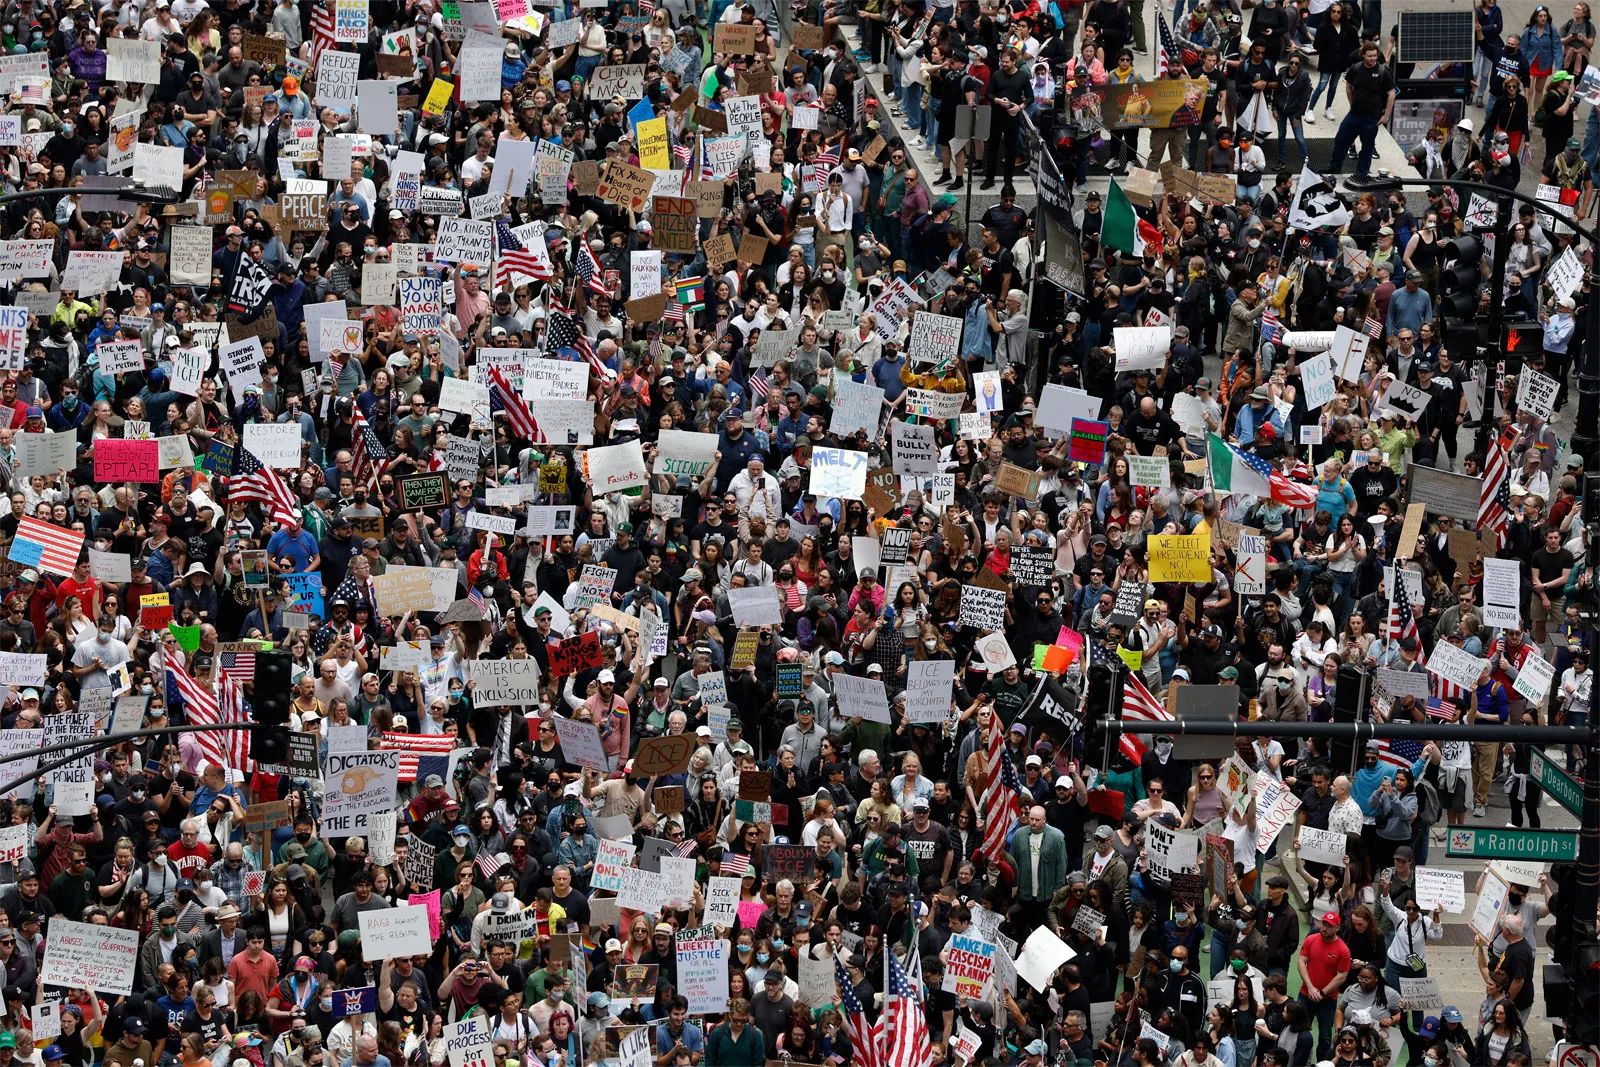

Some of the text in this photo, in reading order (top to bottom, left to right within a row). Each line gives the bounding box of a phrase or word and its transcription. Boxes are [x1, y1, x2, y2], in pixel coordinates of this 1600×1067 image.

[338, 10, 366, 19] KINGS
[338, 20, 366, 28] NO
[338, 29, 367, 38] FASCISTS
[323, 54, 358, 67] REFUSE
[320, 70, 356, 83] RESIST
[319, 84, 355, 100] REVOLT
[597, 85, 639, 98] MAGA
[742, 102, 757, 112] The
[730, 112, 761, 124] PEOPLE
[1395, 120, 1426, 128] Time
[1395, 131, 1408, 140] to
[118, 152, 134, 162] KINGS
[542, 142, 571, 163] HATE
[716, 152, 735, 162] LIES
[399, 172, 408, 181] NO
[294, 182, 313, 192] NO
[397, 181, 419, 190] KINGS
[396, 190, 418, 198] SINCE
[607, 187, 630, 205] Die
[281, 195, 326, 219] PEACE
[395, 199, 416, 209] 1776
[655, 197, 694, 214] END
[443, 221, 491, 235] NO KINGS
[653, 214, 695, 232] CITIZENS
[438, 234, 491, 249] NO TYRANTS
[653, 232, 694, 249] UNITED
[706, 239, 726, 250] SAVE
[436, 245, 490, 261] NO TRUMP
[1, 261, 22, 270] JOIN
[401, 279, 441, 292] DUMP
[403, 292, 440, 304] YOUR
[403, 302, 440, 316] MAGA
[915, 312, 962, 329] INJUSTICE
[914, 323, 955, 338] ANYWHERE
[930, 333, 957, 345] THREAT
[99, 345, 114, 355] THE
[227, 347, 254, 359] STAYING
[113, 353, 128, 361] ICE
[232, 354, 254, 366] SILENT
[116, 360, 141, 371] MELTING
[1305, 359, 1326, 380] NO
[526, 369, 560, 381] NUESTROS
[553, 380, 579, 390] PADRES
[908, 387, 918, 397] NO
[1402, 386, 1421, 398] NO
[118, 442, 158, 452] IN TIME
[896, 439, 930, 450] BULLY
[95, 452, 158, 462] WILL SIGN ITS
[812, 450, 866, 471] MELT
[897, 452, 932, 461] PUPPET
[95, 463, 157, 478] EPITAPH
[662, 458, 709, 474] SCIENCE
[405, 478, 441, 490] THEN THEY
[607, 472, 638, 485] Fascists
[873, 473, 894, 486] NO
[934, 476, 953, 487] RISE
[406, 486, 442, 497] CAME FOR
[540, 484, 561, 493] SERVE
[936, 490, 950, 502] UP
[471, 516, 514, 532] NO KINGS
[886, 531, 910, 546] NO!
[1160, 539, 1201, 549] WE ELECT
[1239, 536, 1265, 553] KINGS
[1156, 550, 1208, 560] PRESIDENTS
[1169, 561, 1189, 569] NOT
[585, 566, 616, 579] FIGHT
[1162, 569, 1195, 579] KINGS
[582, 586, 601, 595] NOT
[964, 585, 1005, 600] YOU FORGOT
[1486, 609, 1517, 621] NO KINGS
[237, 643, 257, 651] KINGS
[653, 638, 666, 646] FOR
[650, 644, 666, 653] ME?
[473, 662, 531, 675] AMERICA
[921, 663, 941, 676] ICE
[496, 677, 510, 687] IS
[908, 678, 941, 690] BELONGS
[474, 688, 537, 703] INCLUSION
[921, 689, 934, 698] MY
[47, 714, 89, 725] THE POWER
[905, 710, 919, 720] NOT
[55, 726, 68, 734] THE
[69, 725, 94, 733] PEOPLE
[647, 742, 686, 764] ICE
[329, 752, 399, 773] DICTATORS
[53, 771, 85, 783] POWER
[662, 788, 677, 798] NO
[1547, 770, 1580, 806] Dearborn
[325, 802, 361, 813] BUT THEY
[324, 815, 351, 830] THE
[1257, 793, 1300, 850] KARAOKE
[371, 828, 393, 841] HEAT
[1150, 825, 1175, 844] DON'T
[1313, 830, 1340, 842] AMERICA
[409, 836, 435, 856] DO YOU
[909, 840, 935, 852] SEIZE
[1151, 839, 1169, 855] LET
[1302, 838, 1324, 850] GREAT
[1488, 834, 1558, 855] Randolph
[1562, 840, 1572, 850] St
[597, 854, 622, 866] RACE
[922, 850, 934, 859] DAY
[407, 861, 433, 876] PEOPLE
[776, 859, 804, 873] ICE
[711, 889, 731, 897] SICK
[710, 902, 731, 912] SHIT
[367, 918, 391, 929] RAGE
[496, 912, 522, 925] DRINK
[59, 936, 82, 945] ABUSES
[370, 930, 418, 941] THE REGIME
[676, 929, 695, 940] STOP
[677, 940, 714, 951] LIBERTY
[953, 934, 996, 955] WAKE UP
[678, 950, 721, 961] JUSTICE
[949, 948, 991, 968] FASCISM
[947, 961, 991, 984] TYRANNY
[956, 982, 982, 999] HERE
[345, 1003, 361, 1011] NO
[457, 1021, 476, 1035] DUE
[447, 1031, 491, 1051] PROCESS
[463, 1048, 483, 1063] for
